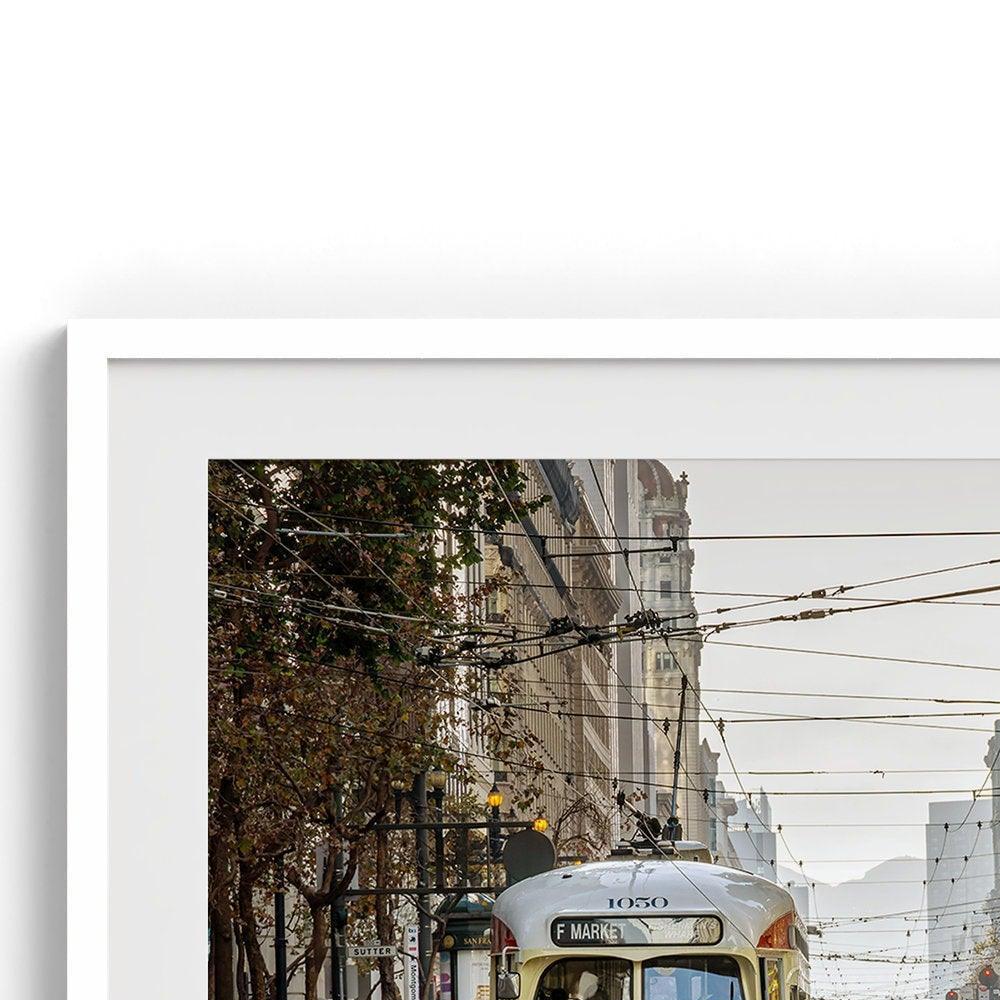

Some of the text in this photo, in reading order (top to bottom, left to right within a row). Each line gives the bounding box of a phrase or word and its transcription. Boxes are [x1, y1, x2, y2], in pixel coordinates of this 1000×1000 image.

[608, 897, 669, 909] 1050
[556, 923, 626, 940] F MARKET
[354, 947, 391, 956] SUTTER
